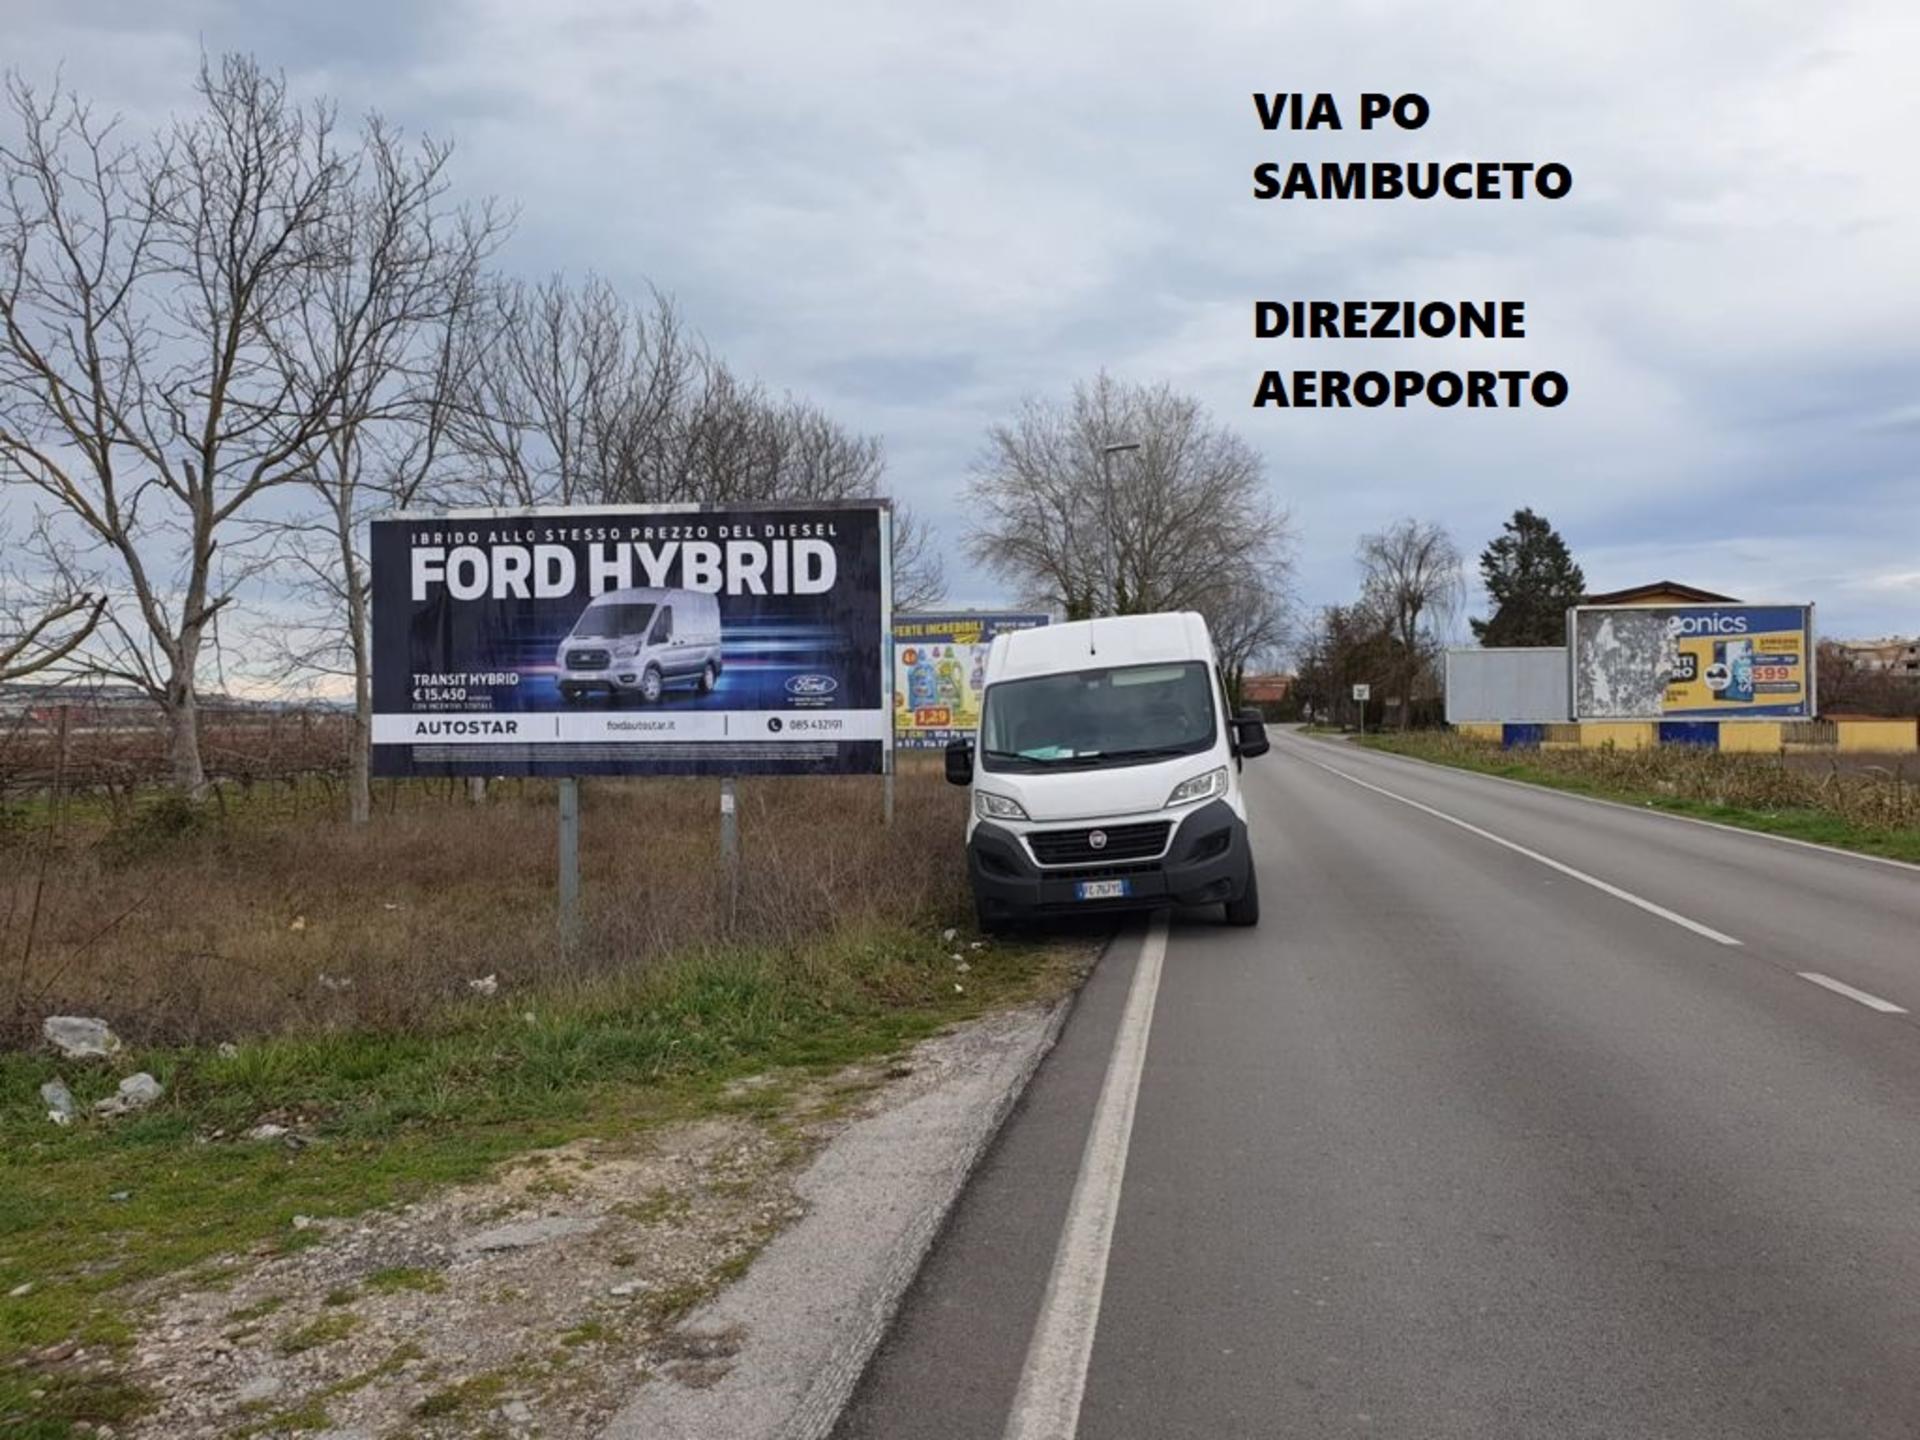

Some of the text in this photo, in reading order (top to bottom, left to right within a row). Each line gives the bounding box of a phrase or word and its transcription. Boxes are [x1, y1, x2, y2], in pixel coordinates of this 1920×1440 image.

[411, 523, 838, 545] IBRIDO ALLO STESSO PREZZO DEL DIESEL
[411, 538, 838, 601] FORD HYBRID
[413, 672, 519, 686] TRANSIT HYBRID
[1753, 666, 1789, 680] 599
[424, 687, 466, 701] 15.450
[416, 720, 518, 735] AUTOSTAR
